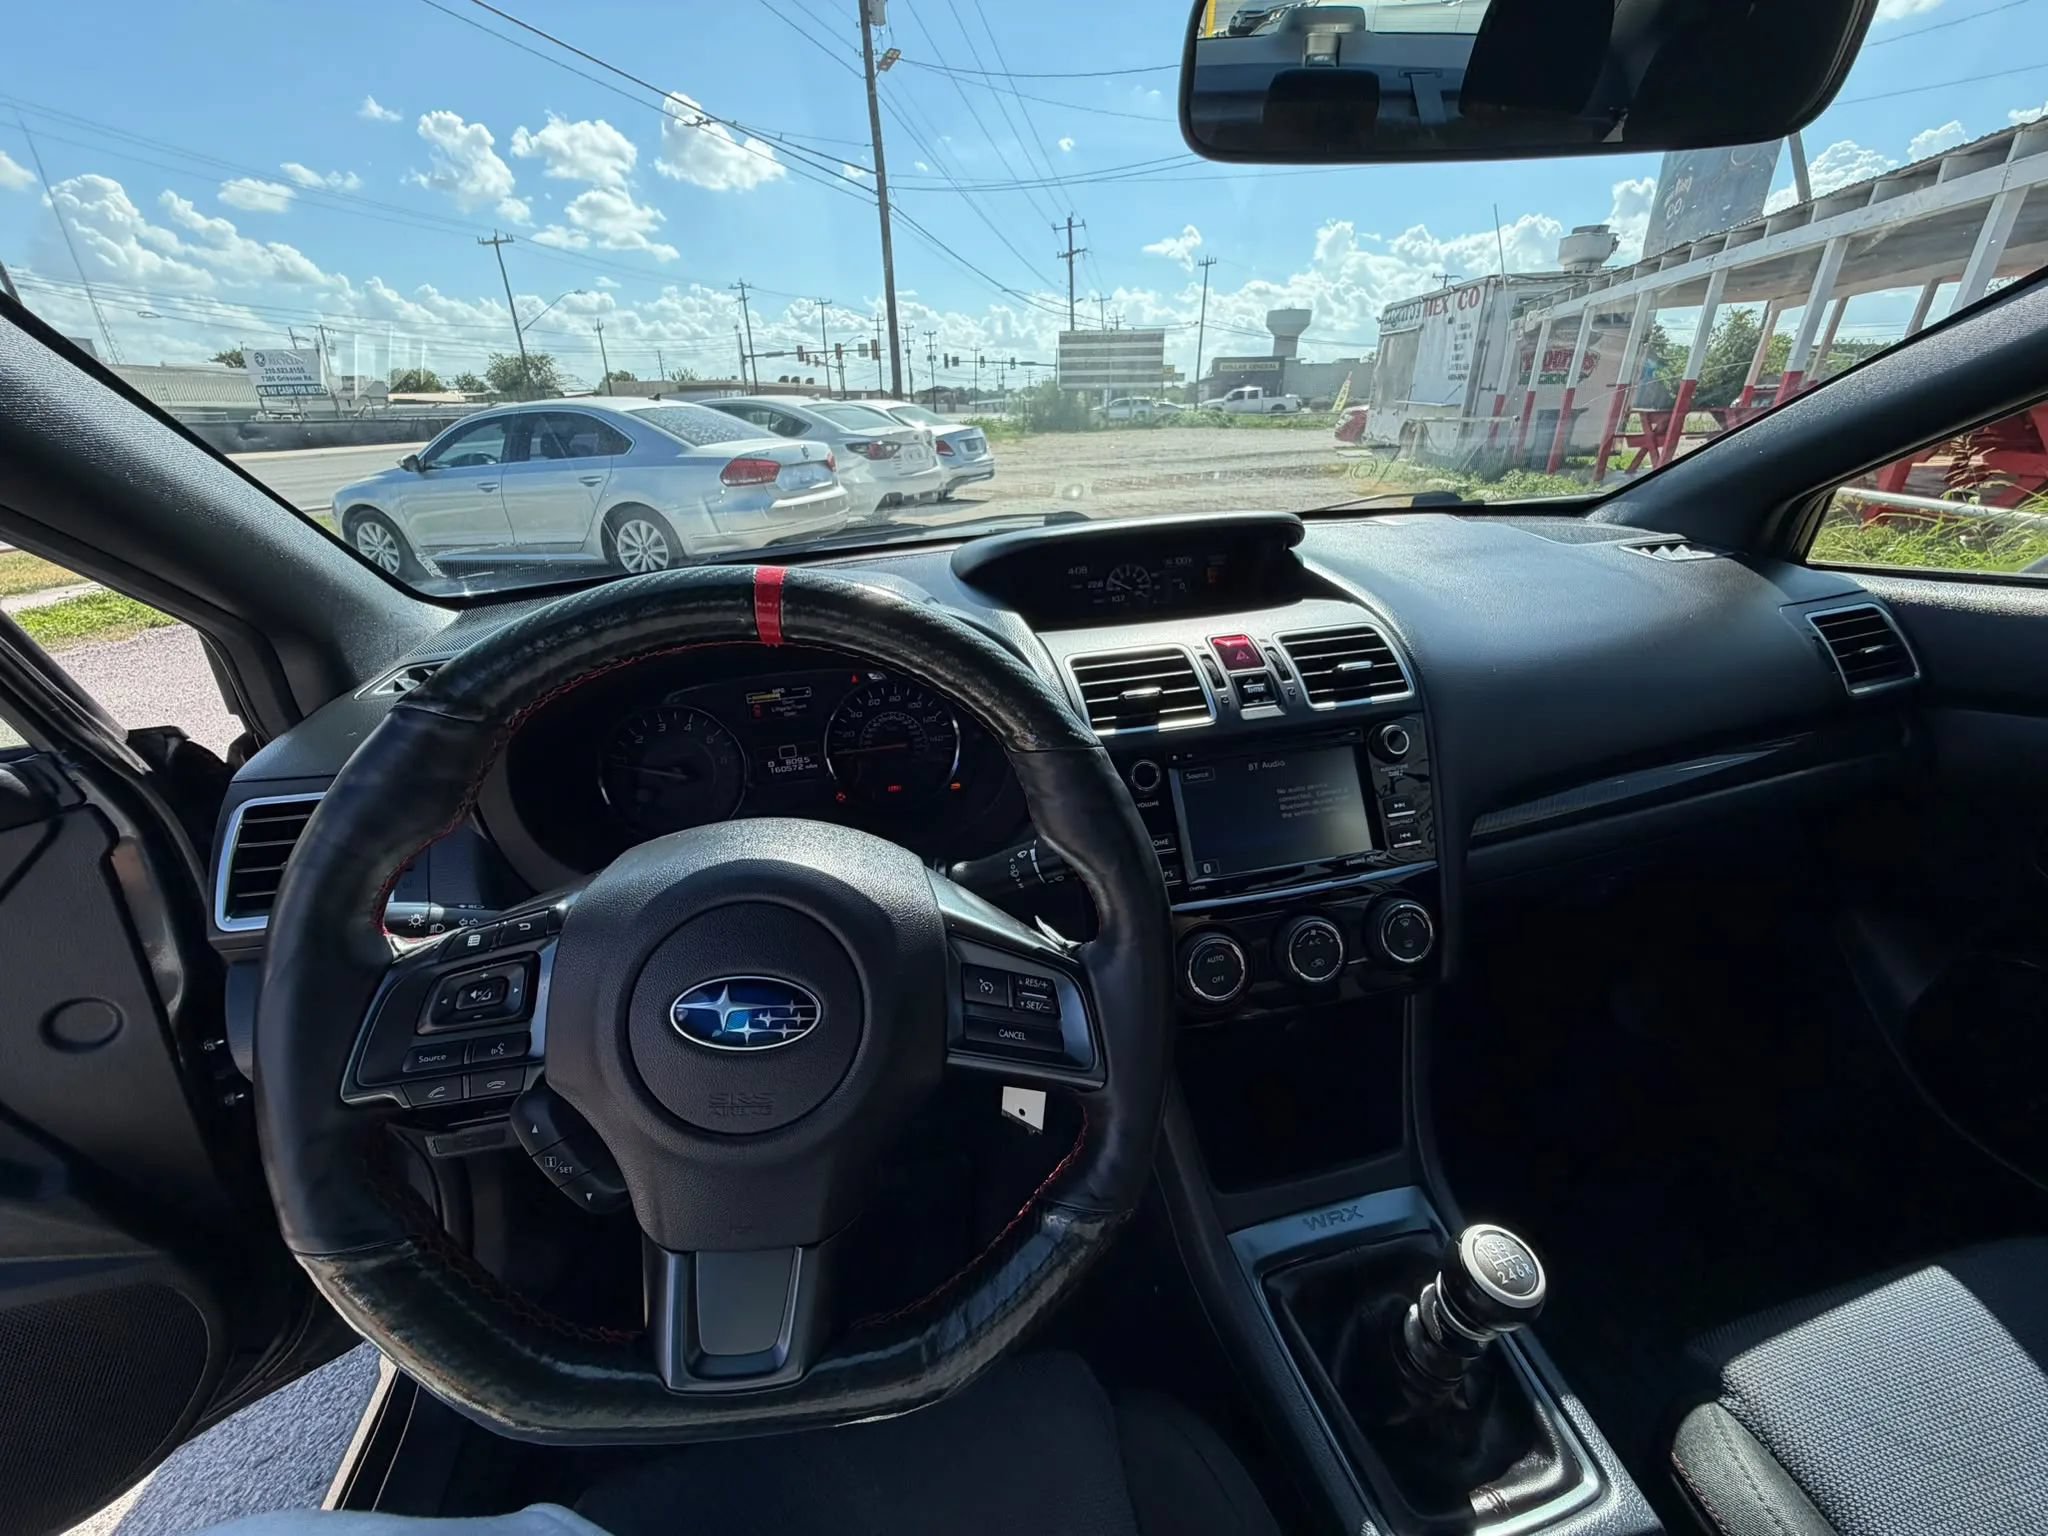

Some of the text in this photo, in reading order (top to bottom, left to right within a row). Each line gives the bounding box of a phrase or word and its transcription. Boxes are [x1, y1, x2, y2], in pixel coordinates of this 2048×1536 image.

[1248, 760, 1286, 771] BT Audio
[1185, 771, 1209, 780] Source
[1152, 838, 1169, 847] OME
[1207, 954, 1225, 963] AUTO
[1211, 975, 1225, 984] OFF
[998, 1028, 1027, 1041] CANCEL
[417, 1053, 448, 1064] Source
[1302, 1205, 1365, 1231] WRX
